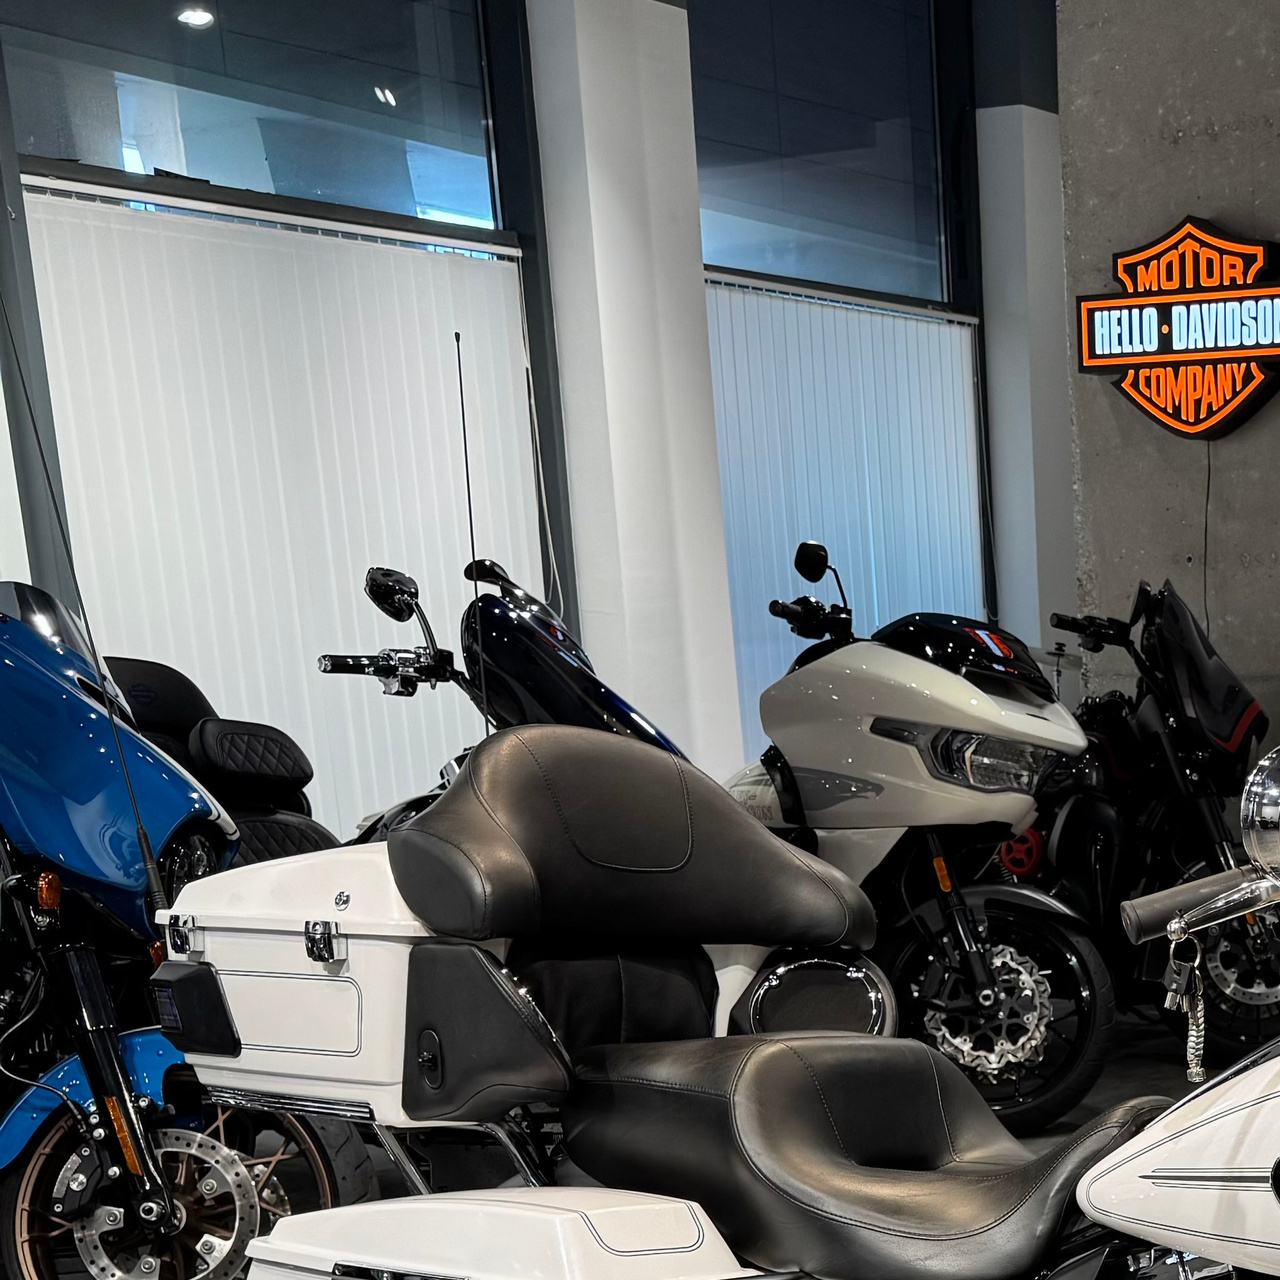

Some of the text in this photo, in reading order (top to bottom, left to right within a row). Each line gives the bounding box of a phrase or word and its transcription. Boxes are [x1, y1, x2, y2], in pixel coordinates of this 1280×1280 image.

[1137, 238, 1244, 292] MOTOR
[1094, 306, 1158, 355] HELLO
[1138, 362, 1247, 423] COMPANY
